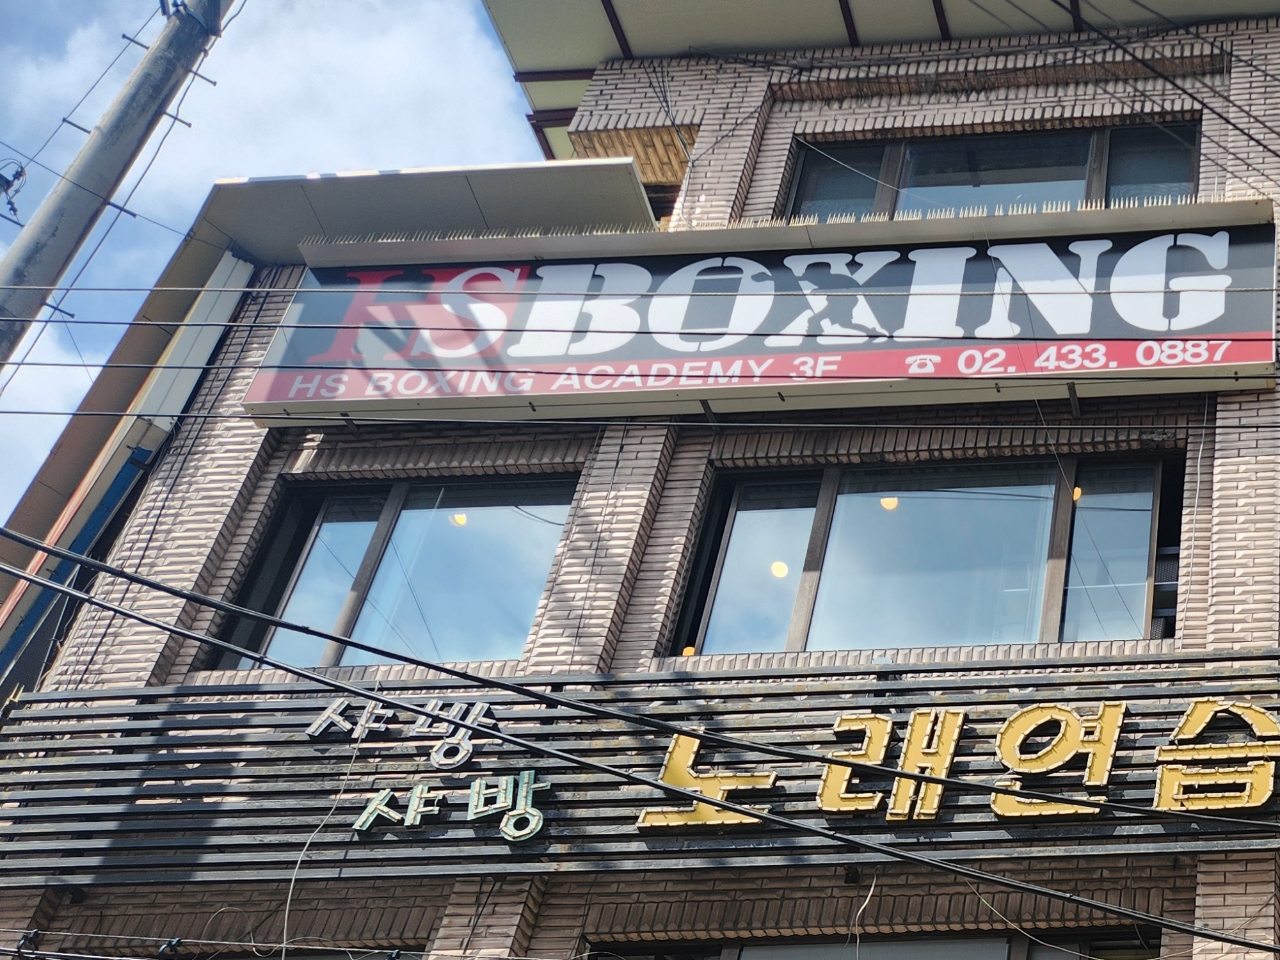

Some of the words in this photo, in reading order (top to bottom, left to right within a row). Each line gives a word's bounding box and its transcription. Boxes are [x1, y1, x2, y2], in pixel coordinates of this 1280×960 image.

[289, 374, 348, 400] HS
[364, 367, 534, 397] BOXING
[550, 357, 775, 391] ACADEMY
[791, 355, 843, 382] 3F
[1136, 339, 1233, 365] 0887
